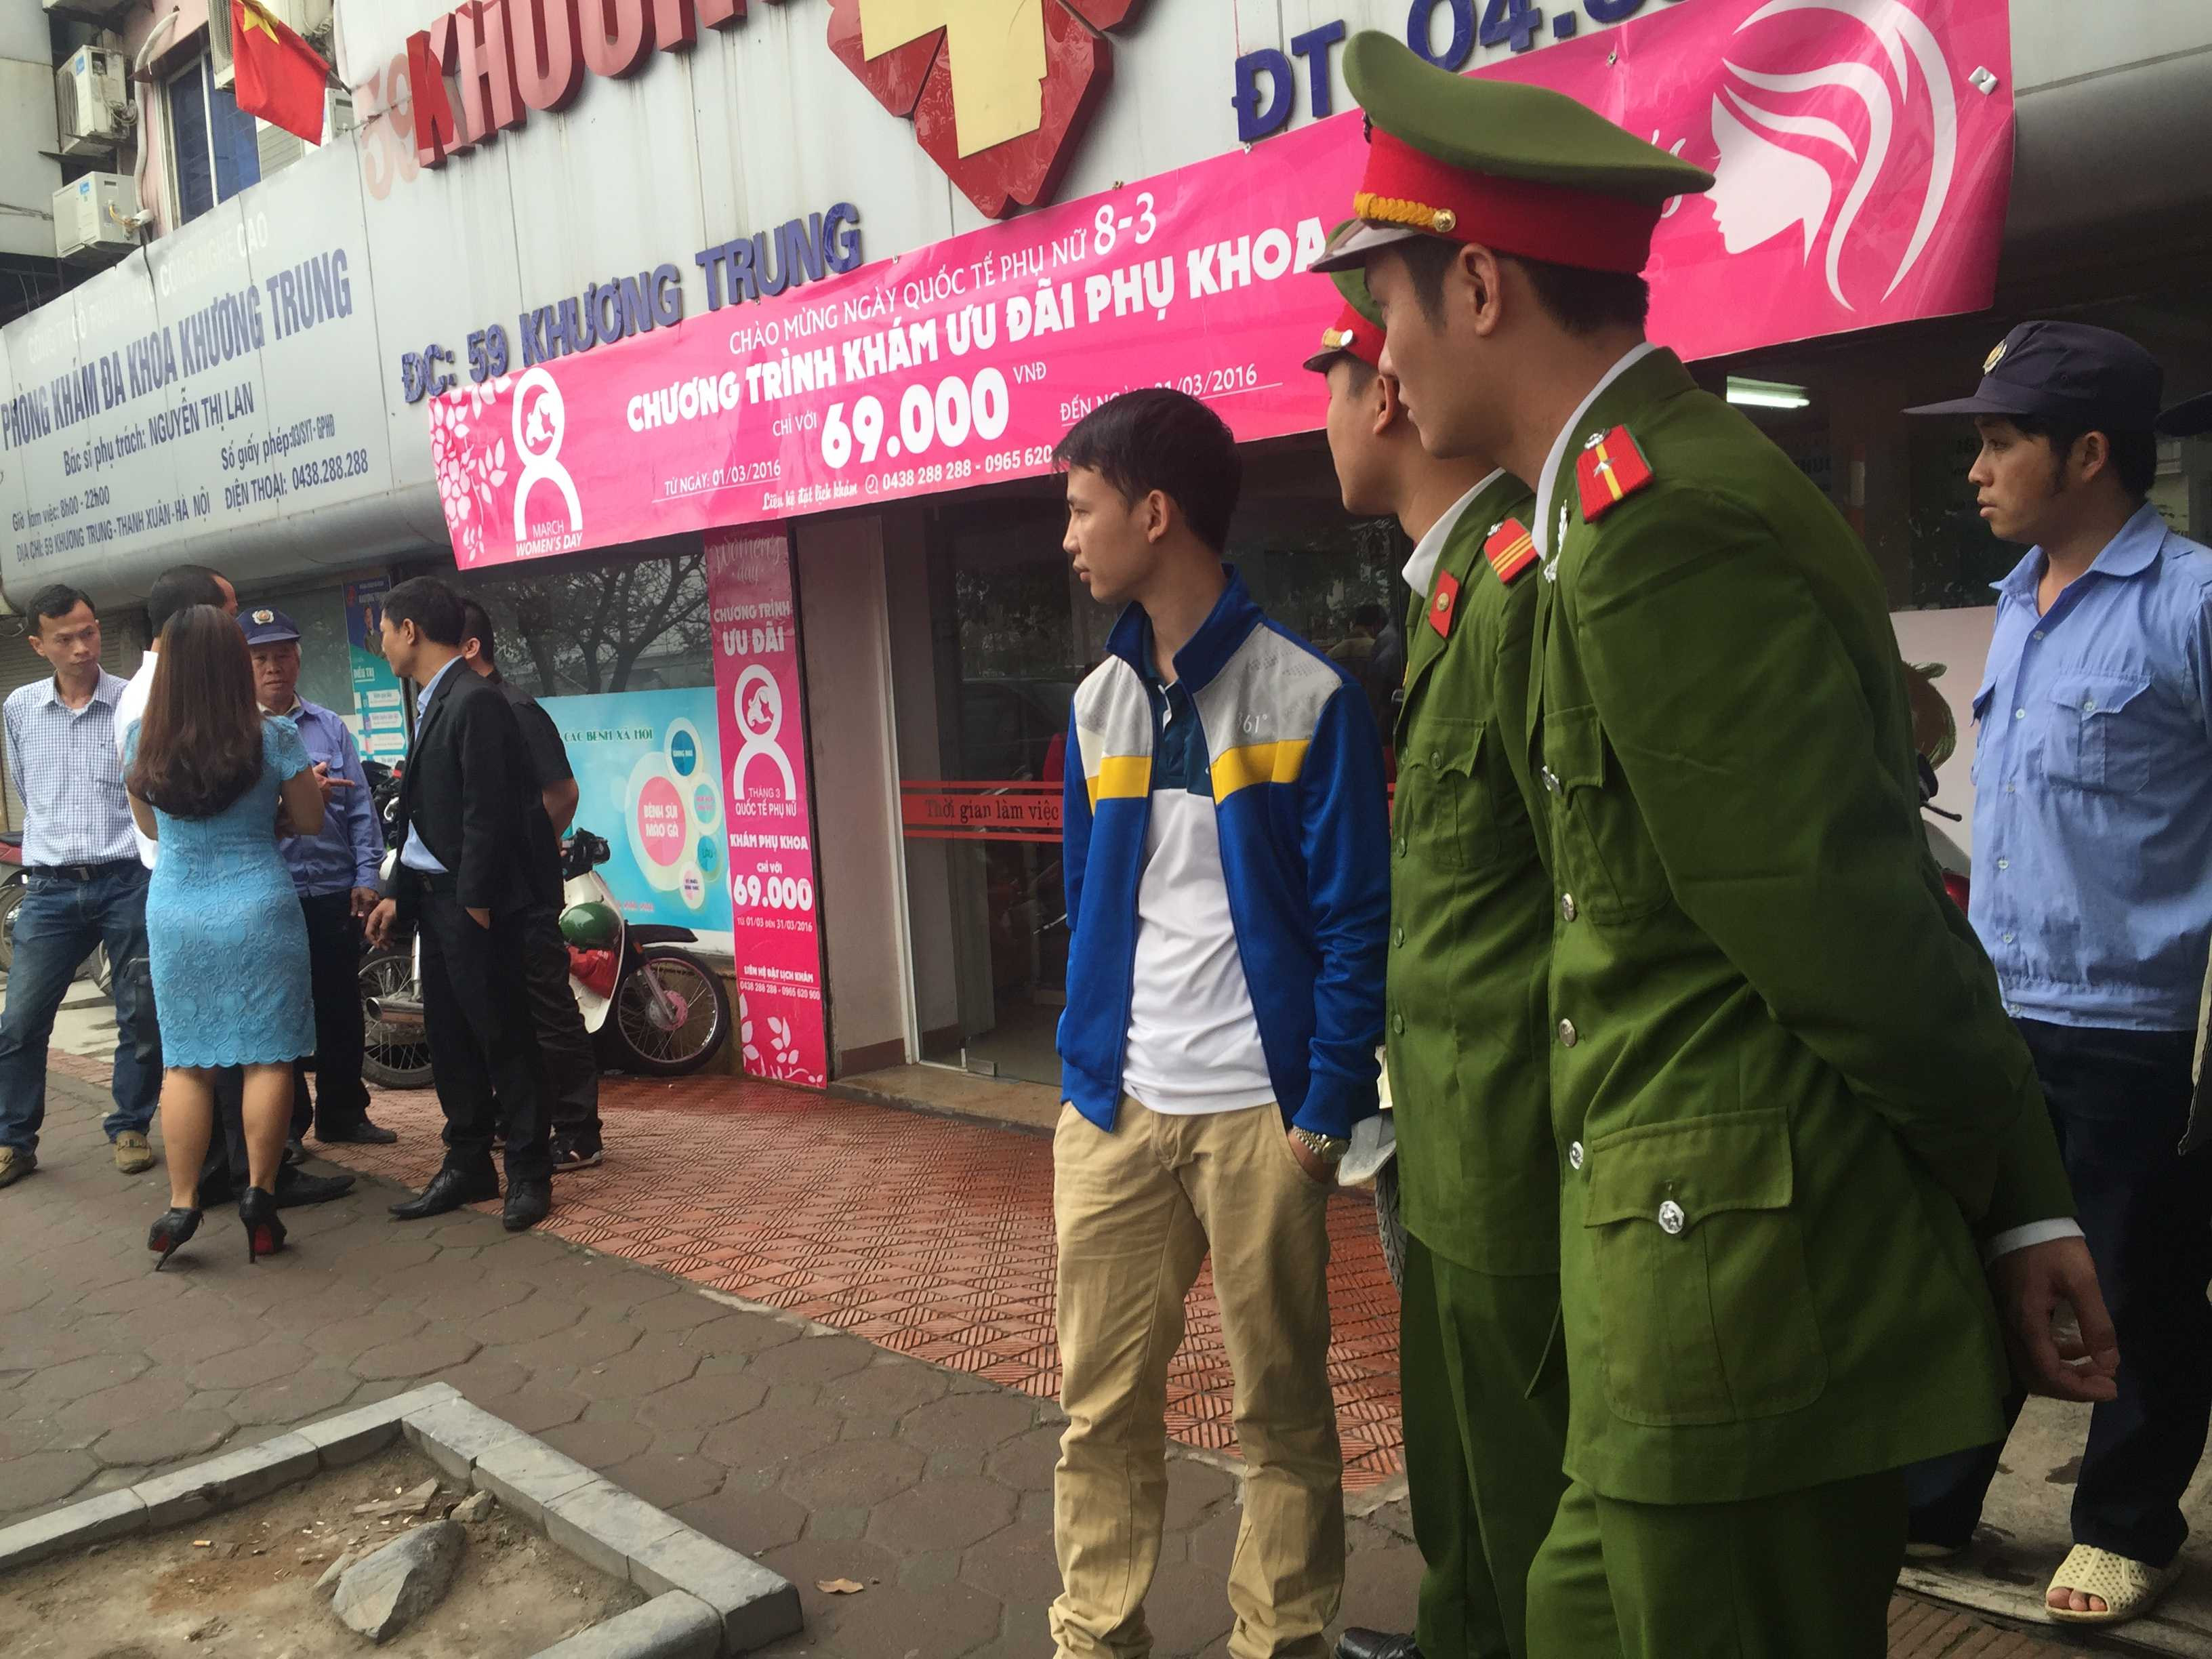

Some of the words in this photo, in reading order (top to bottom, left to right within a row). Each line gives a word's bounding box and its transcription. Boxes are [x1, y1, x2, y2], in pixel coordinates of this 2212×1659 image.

[1232, 19, 1346, 142] ĐT
[238, 211, 268, 258] CAO
[730, 321, 779, 355] CHÀO
[784, 304, 838, 337] MỪNG
[844, 287, 897, 325] NGÀY
[903, 268, 966, 310] QUỐC
[970, 251, 994, 287] TẾ
[1001, 246, 1044, 280] PHỤ
[1052, 228, 1088, 268] NỮ
[1093, 192, 1157, 256] 8-3
[401, 344, 455, 403] ĐC:
[467, 324, 508, 383] 59
[520, 265, 681, 367] KHƯƠNG
[695, 202, 863, 312] TRUNG
[626, 369, 740, 433] CHƯƠNG
[745, 346, 837, 405] TRÌNH
[842, 316, 939, 383] KHÁM
[945, 302, 998, 357] ƯU
[1005, 276, 1076, 344] ĐÃI
[1084, 255, 1176, 324] PHỤ
[1187, 216, 1328, 300] KHOA
[1, 383, 51, 451] PHÒNG
[51, 357, 100, 430] KHÁM
[100, 351, 127, 410] ĐA
[126, 326, 178, 399] KHOA
[178, 285, 266, 378] KHƯƠNG
[266, 248, 353, 341] TRUNG
[772, 411, 792, 437] CHỈ
[794, 409, 817, 434] VỚI
[820, 367, 1010, 470] 69.000
[1012, 361, 1047, 384] VNĐ
[1060, 394, 1091, 422] ĐẾN
[63, 447, 81, 476] Bác
[95, 436, 114, 472] phụ
[116, 425, 146, 458] trách:
[149, 387, 200, 446] NGUYỄN
[201, 392, 224, 431] THỊ
[225, 382, 254, 420] LAN
[221, 440, 235, 470] Số
[238, 432, 260, 470] giấy
[664, 476, 678, 496] TỪ
[680, 472, 710, 493] NGÀY:
[713, 459, 781, 487] 01/03/2016
[762, 492, 783, 510] Liên
[785, 489, 796, 510] hệ
[798, 486, 813, 508] đặt
[815, 483, 831, 505] lịch
[834, 480, 857, 499] khám
[882, 469, 914, 490] 0438
[918, 464, 942, 485] 288
[946, 459, 971, 479] 288
[985, 450, 1021, 472] 0965
[1025, 445, 1052, 466] 620
[12, 512, 25, 531] Giờ
[28, 508, 42, 529] làm
[60, 495, 79, 518] 8h00
[85, 485, 110, 510] 22h00
[16, 542, 29, 567] ĐỊA
[44, 537, 54, 556] 59
[54, 528, 85, 554] KHƯƠNG
[86, 520, 113, 545] TRUNG
[117, 510, 144, 537] THANH
[193, 486, 211, 522] NỘI
[225, 478, 249, 512] ĐIỆN
[251, 472, 287, 503] THOẠI:
[292, 449, 369, 490] 0438.288.288
[516, 536, 561, 557] WOMEN'S
[563, 533, 583, 549] DAY
[533, 519, 565, 537] MARCH
[714, 604, 757, 623] CHƯƠNG
[759, 598, 790, 618] TRÌNH
[722, 628, 748, 656] ƯU
[752, 621, 785, 653] ĐÃI
[735, 798, 756, 817] QUỐC
[758, 798, 767, 817] TẾ
[769, 802, 784, 819] PHỤ
[785, 800, 797, 817] NỮ
[748, 787, 775, 798] THÁNG
[775, 788, 781, 798] 3
[926, 797, 954, 817] Thời
[960, 798, 991, 824] gian
[996, 797, 1024, 819] làm
[1029, 800, 1059, 826] việc
[730, 831, 757, 848] KHÁM
[758, 834, 778, 853] PHỤ
[780, 836, 808, 851] KHOA
[769, 861, 783, 874] VỚI
[733, 874, 813, 912] 69.000
[746, 916, 764, 928] 01/03
[777, 919, 813, 933] 31/03/2016
